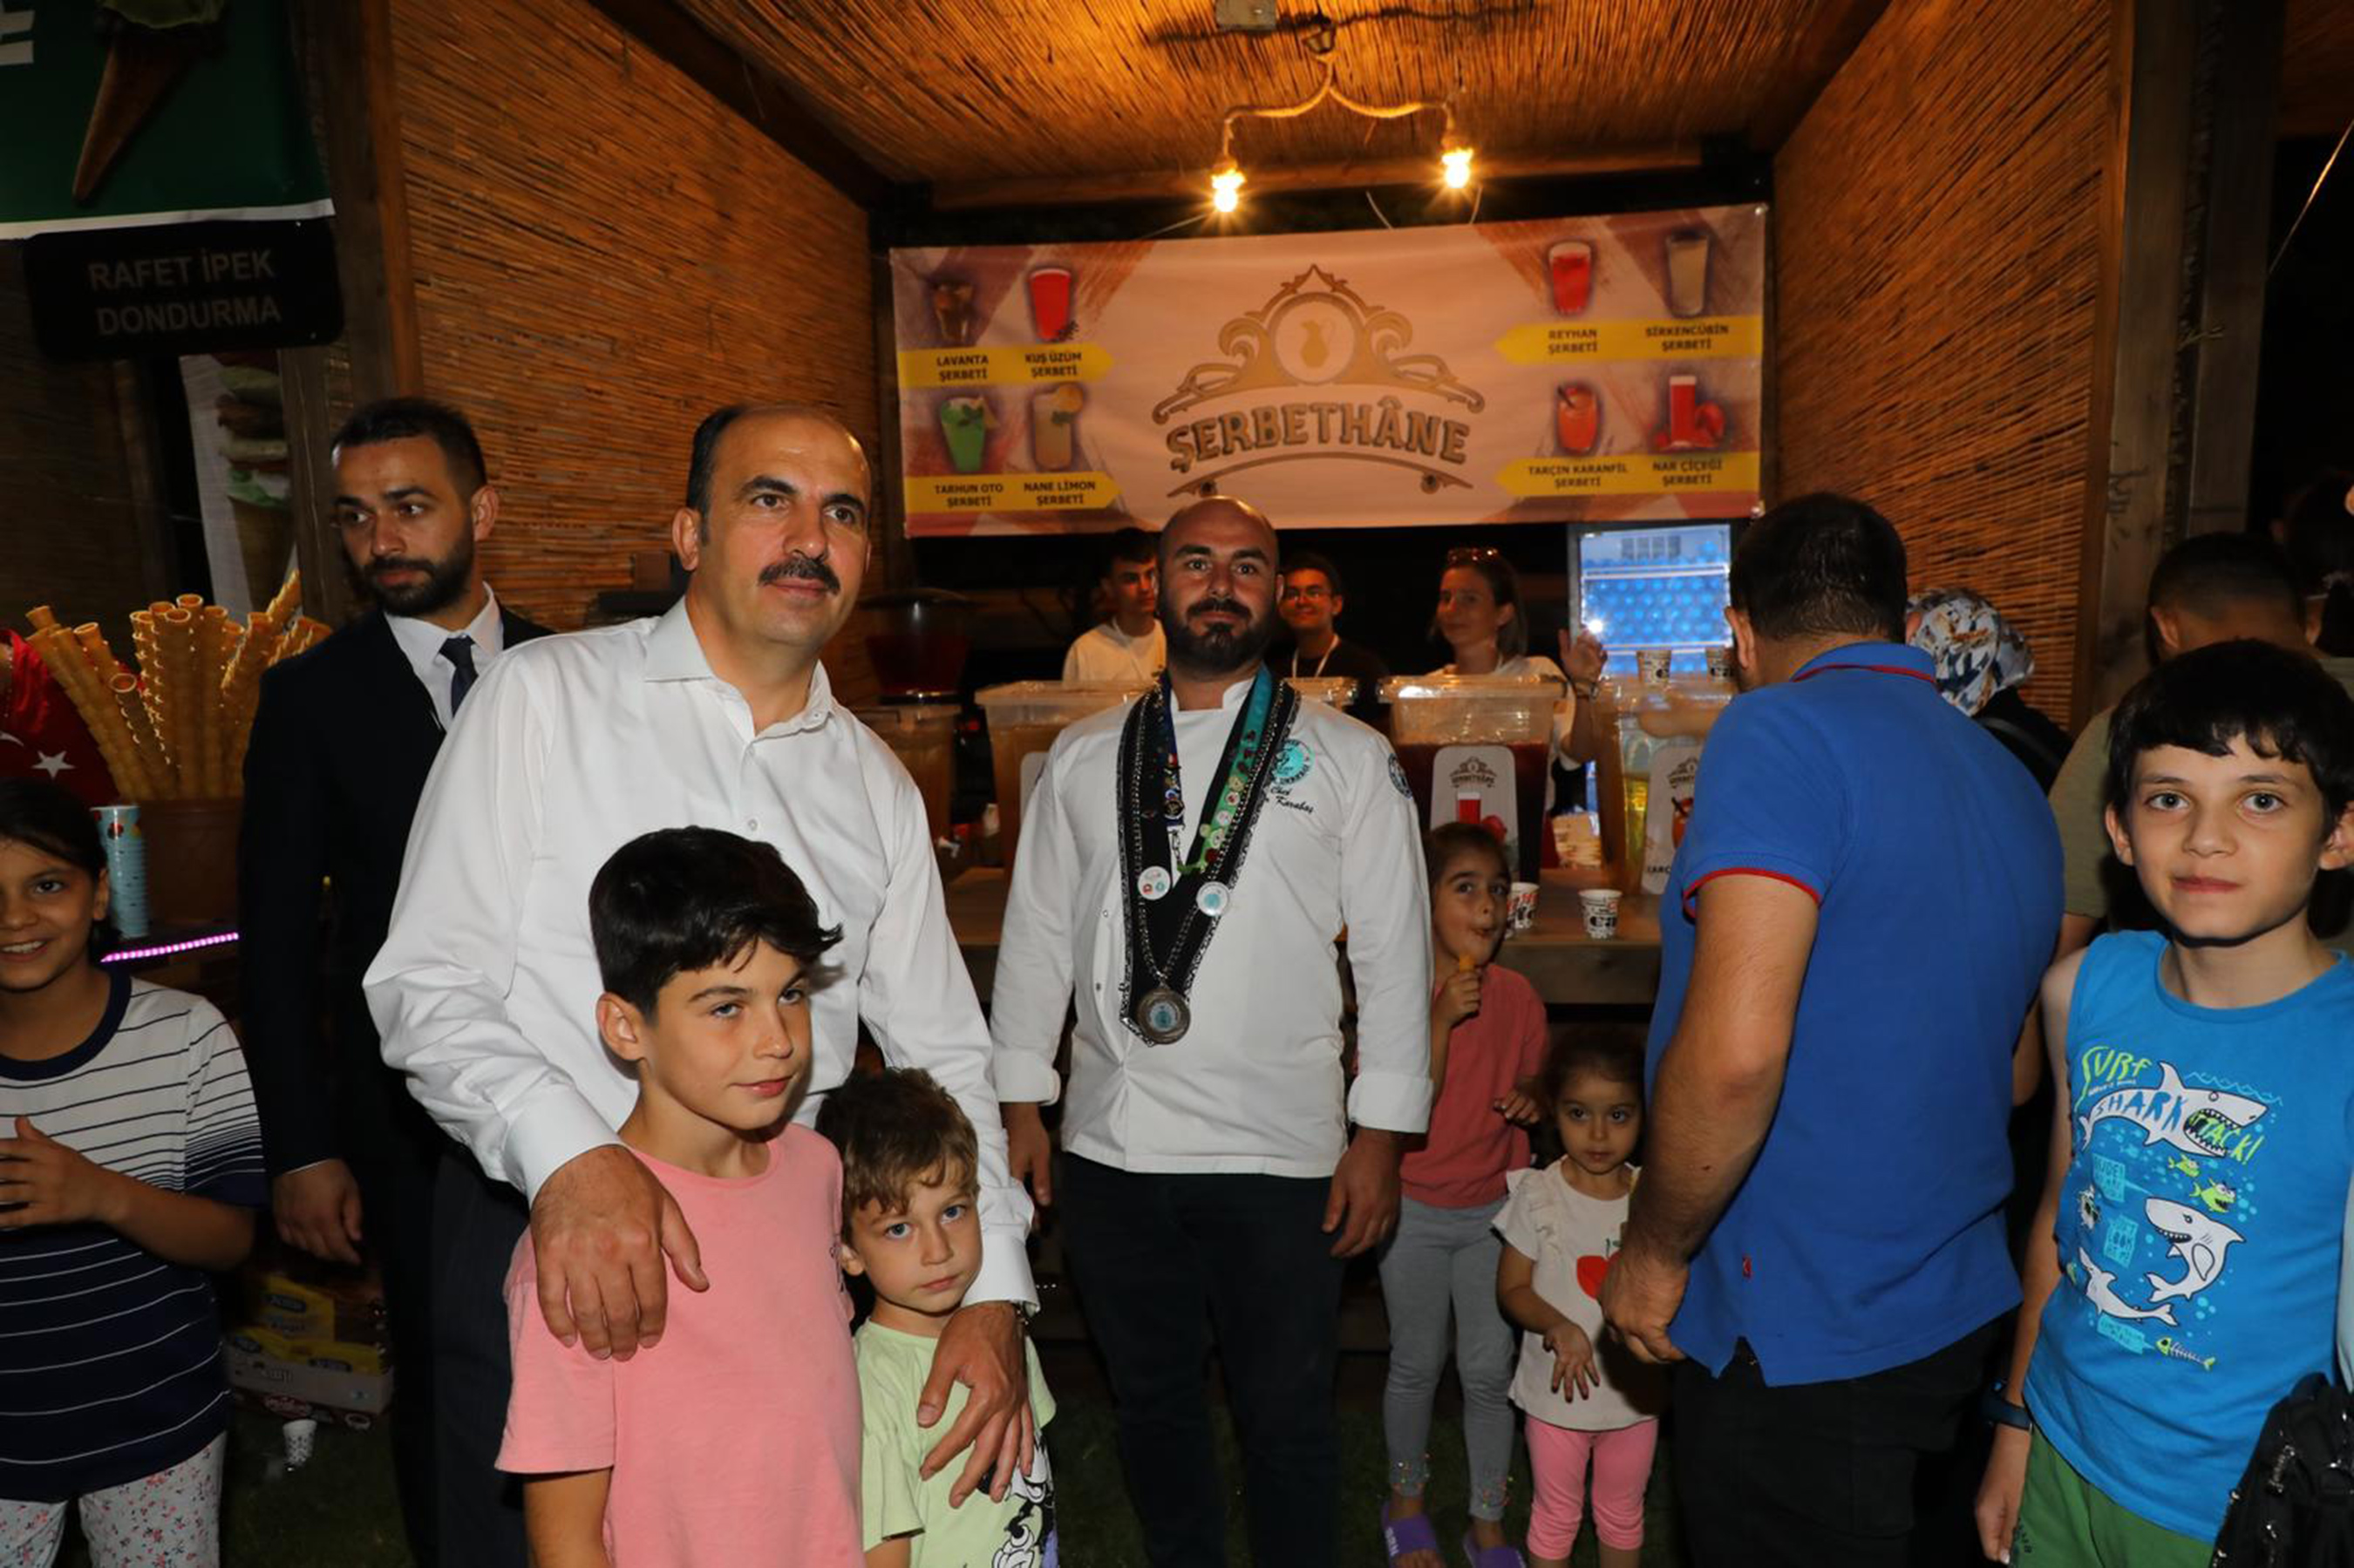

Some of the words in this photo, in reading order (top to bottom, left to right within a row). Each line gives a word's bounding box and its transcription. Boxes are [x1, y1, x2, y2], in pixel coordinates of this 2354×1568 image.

[87, 256, 192, 292] RAFET
[200, 247, 276, 282] İPEK
[95, 295, 282, 336] DONDURMA
[1548, 329, 1597, 340] REYHAN
[1548, 340, 1597, 355] ŞERBETİ
[1662, 337, 1711, 351] ŞERBETİ
[936, 355, 989, 366] LAVANTA
[939, 368, 988, 382] ŞERBETİ
[1031, 364, 1078, 378] ŞERBETİ
[1167, 395, 1470, 473] ŞERBETHÂNE
[1652, 461, 1677, 472] NAR
[1024, 481, 1053, 492] NANE
[1057, 479, 1096, 492] LİMON
[1554, 477, 1601, 489] ŞERBETİ
[1663, 473, 1711, 486] ŞERBETİ
[935, 484, 978, 494] TARHUN
[947, 495, 991, 508] ŞERBETİ
[1036, 493, 1084, 507] ŞERBETİ
[2094, 1089, 2188, 1131] SHARK
